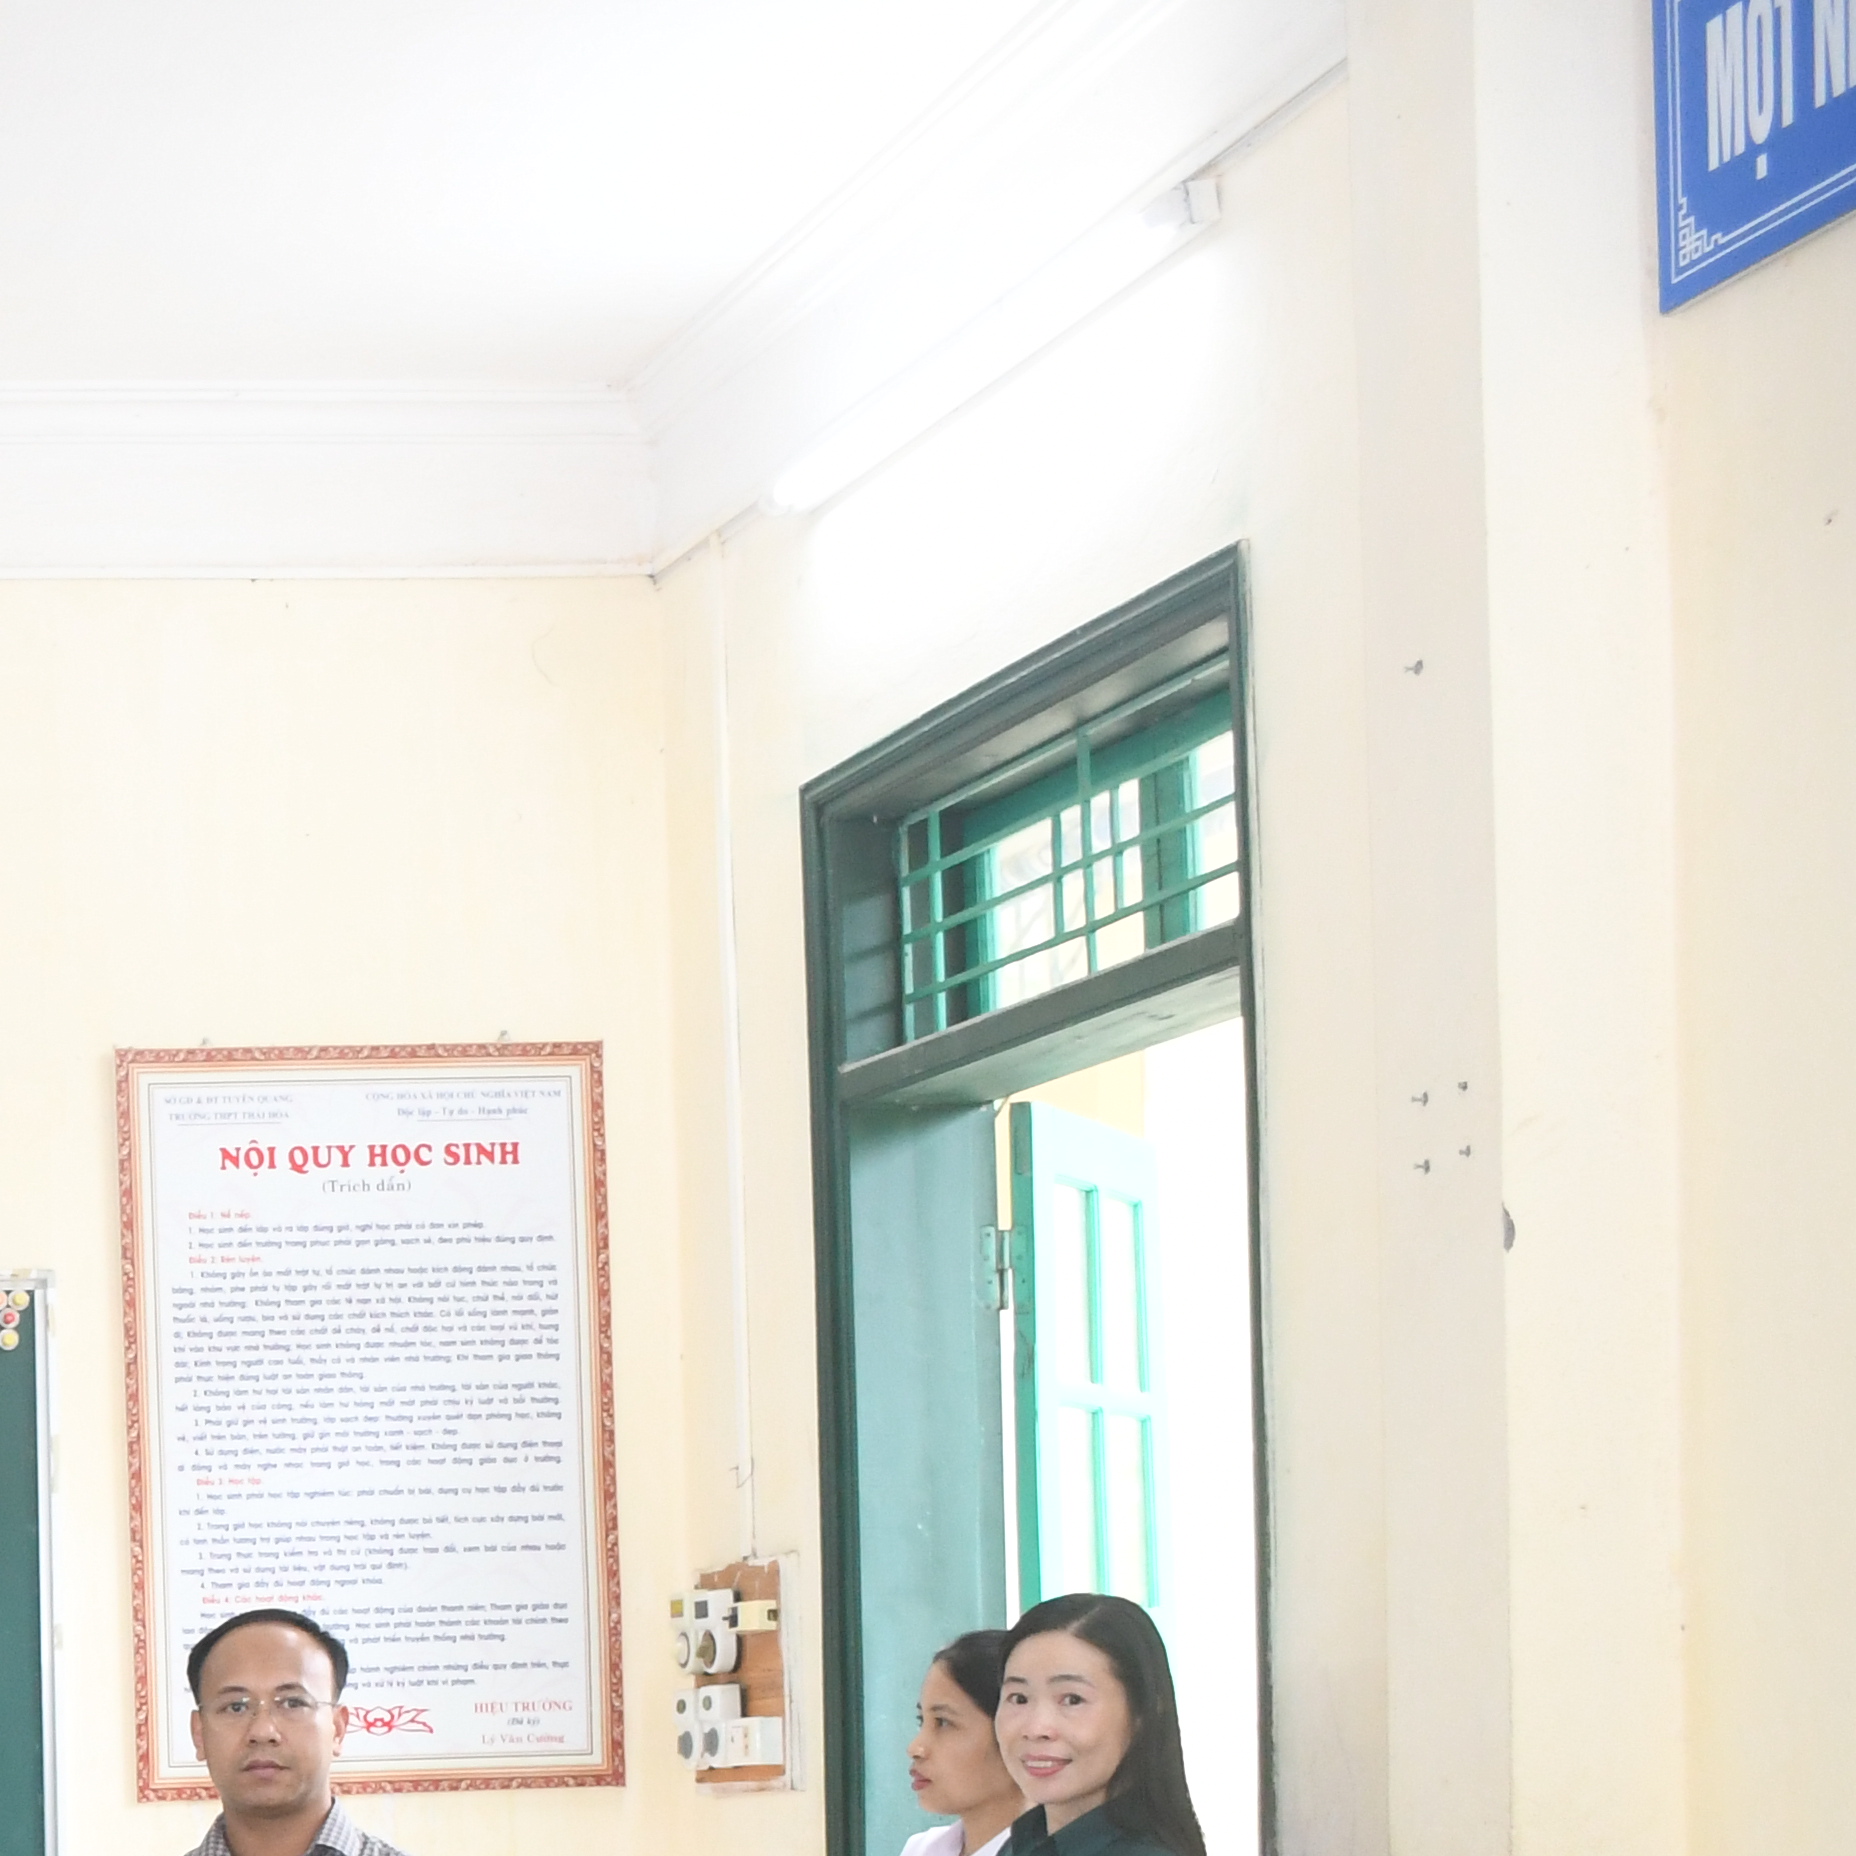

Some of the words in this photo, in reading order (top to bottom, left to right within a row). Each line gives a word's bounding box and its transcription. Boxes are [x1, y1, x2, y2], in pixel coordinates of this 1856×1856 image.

[219, 1139, 276, 1177] NỘI
[288, 1144, 356, 1174] QUY
[367, 1143, 432, 1174] HỌC
[443, 1141, 519, 1166] SINH
